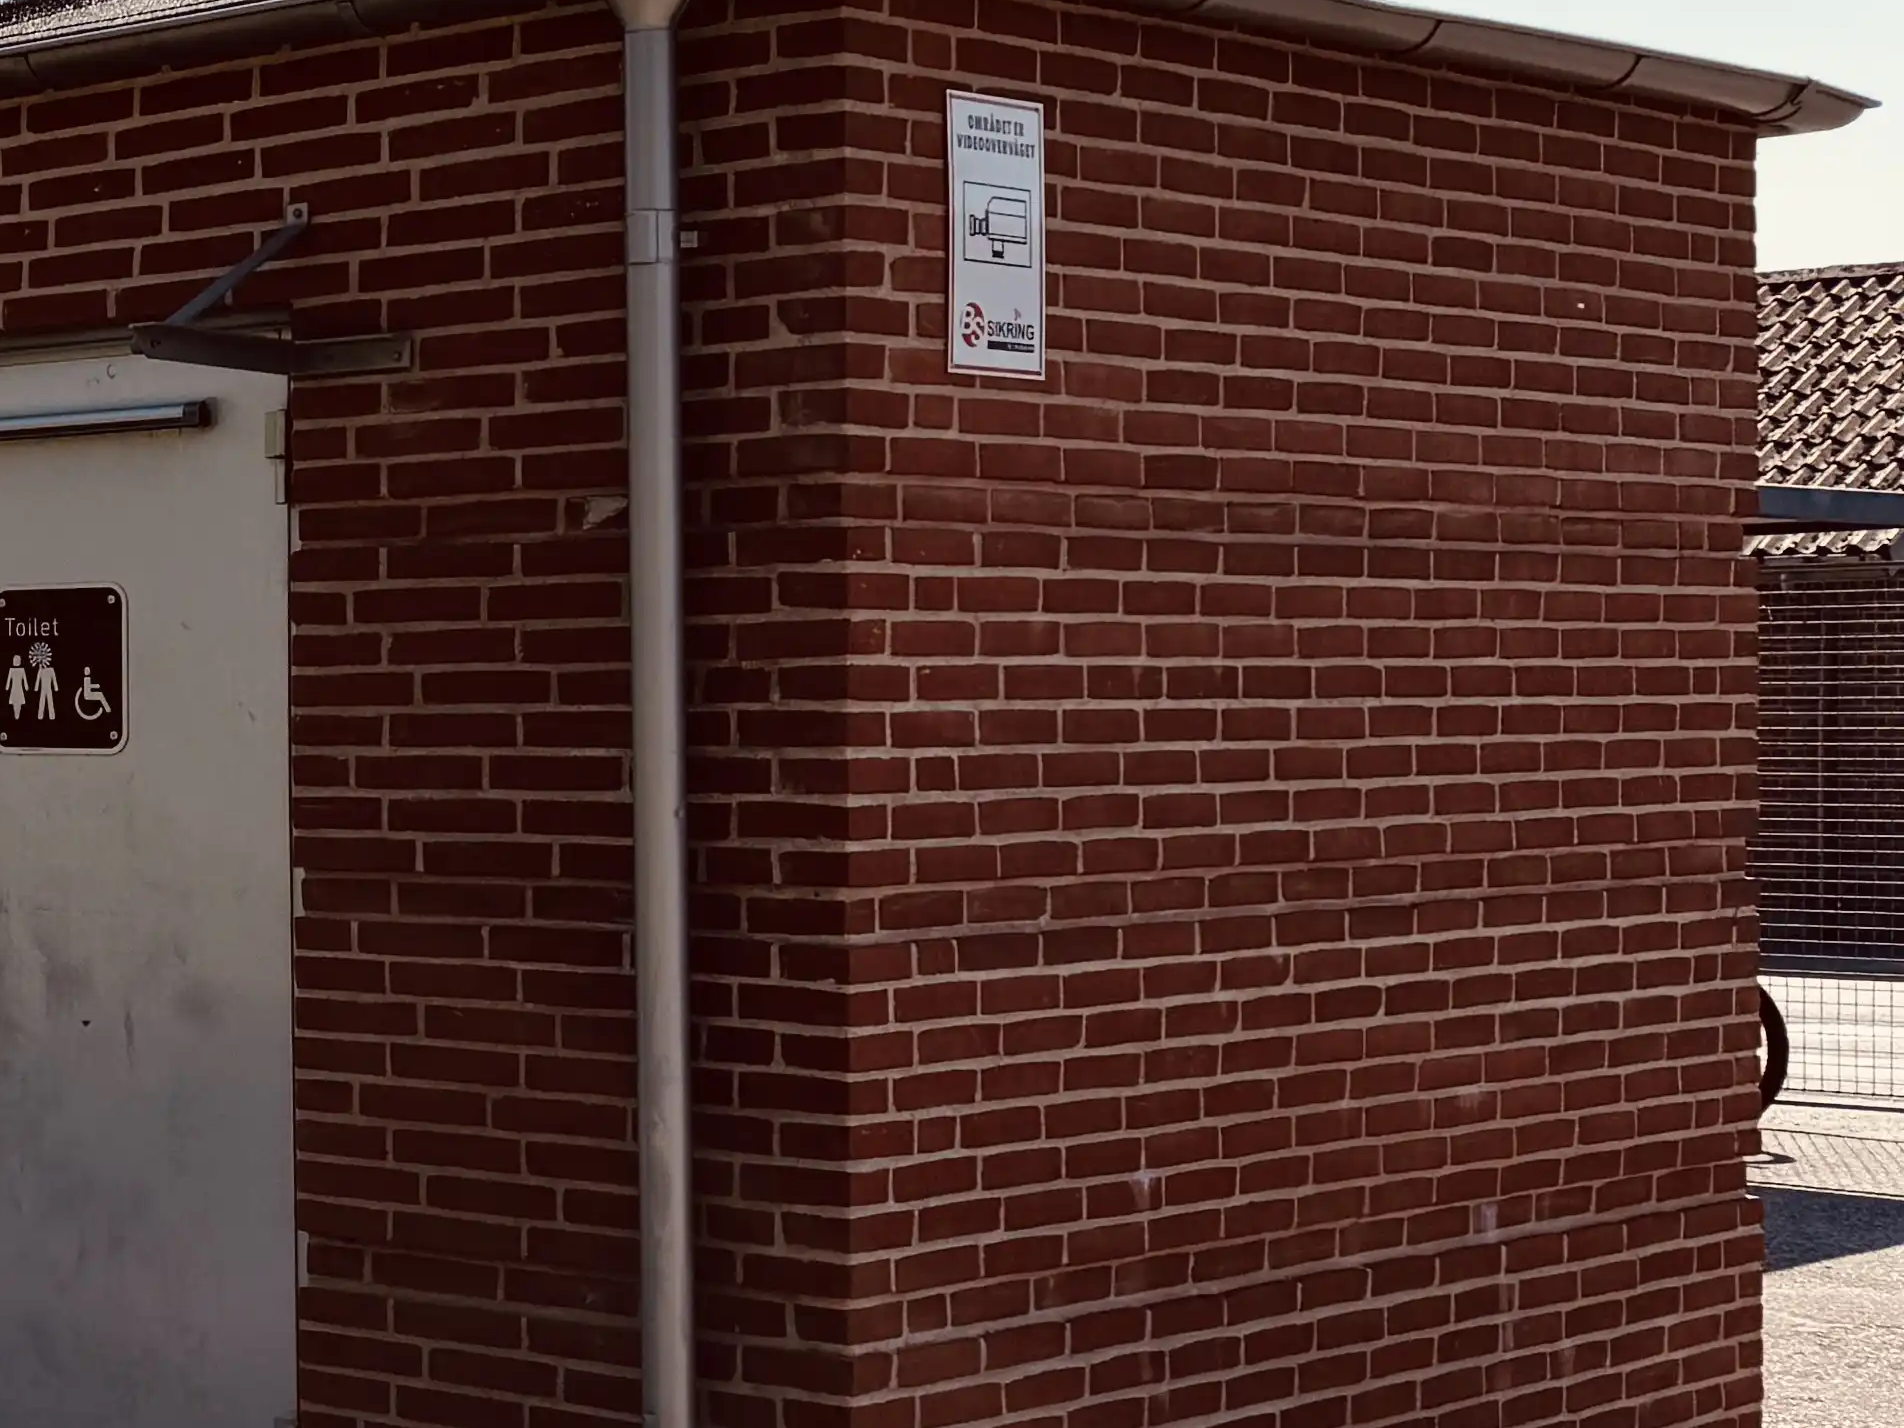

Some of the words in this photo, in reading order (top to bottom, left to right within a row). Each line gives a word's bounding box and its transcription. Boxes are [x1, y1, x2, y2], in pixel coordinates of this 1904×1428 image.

[967, 112, 1012, 135] OMRÅDET
[1014, 121, 1024, 136] ER
[987, 320, 1035, 341] SIKRING
[4, 617, 59, 637] Toilet
